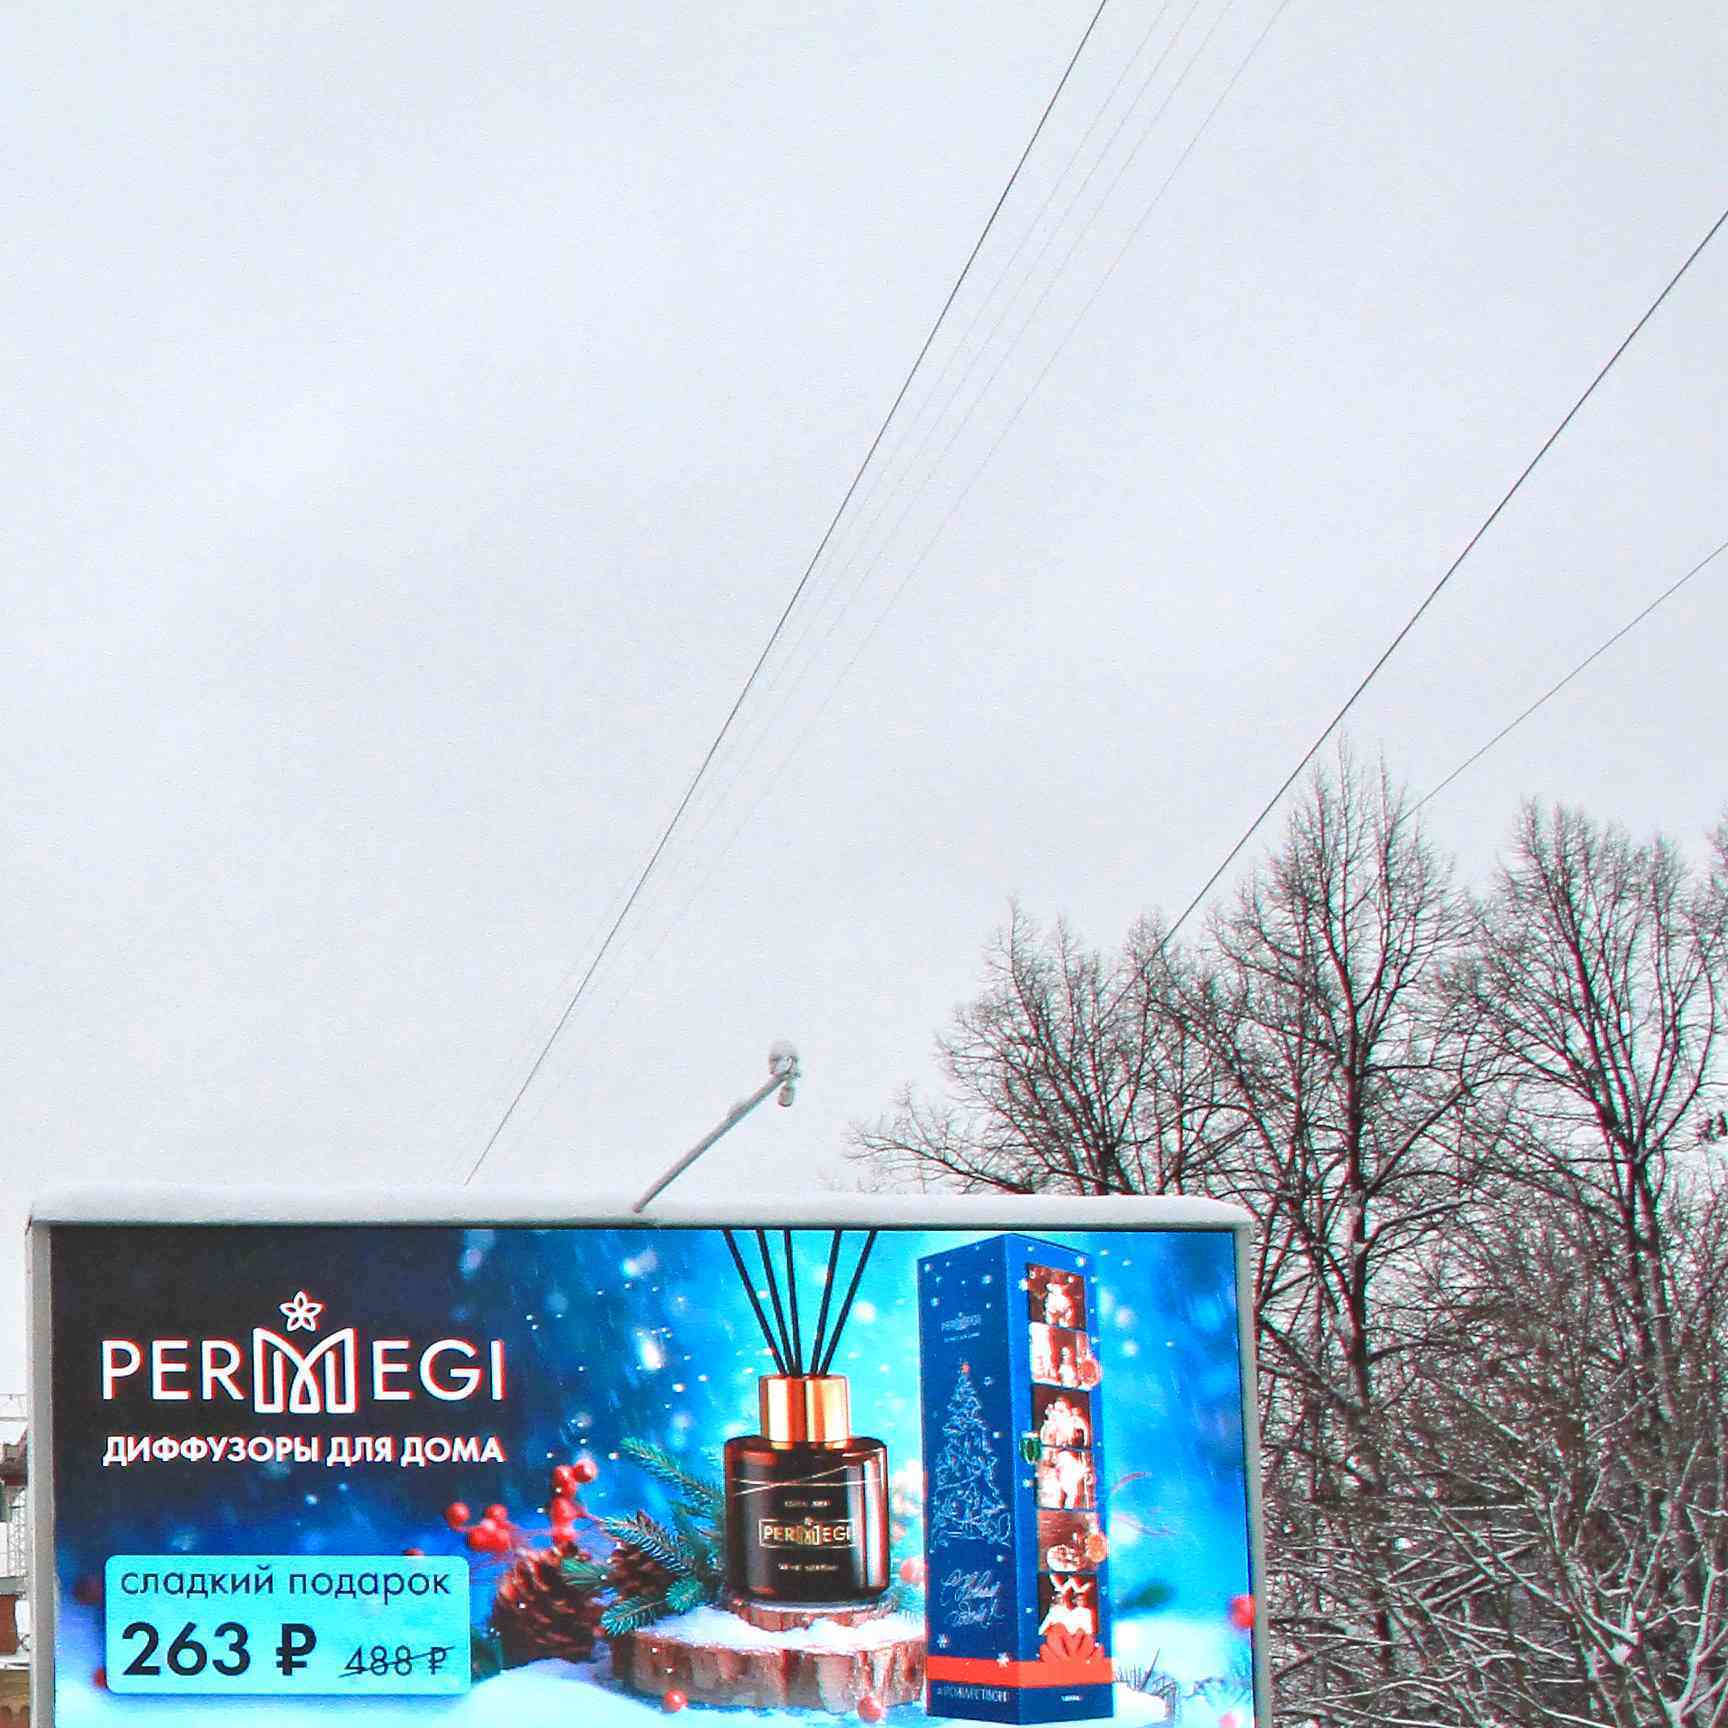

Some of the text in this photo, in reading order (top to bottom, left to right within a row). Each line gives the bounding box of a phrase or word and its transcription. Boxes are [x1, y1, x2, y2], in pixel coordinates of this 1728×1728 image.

[101, 1327, 505, 1415] PERMEGI
[102, 1436, 505, 1467] ДИФФУЗОРЫ ДЛЯ ДОМА
[120, 1563, 451, 1606] сладкий подарок
[121, 1621, 318, 1677] 263 ₽
[344, 1644, 413, 1677] 488
